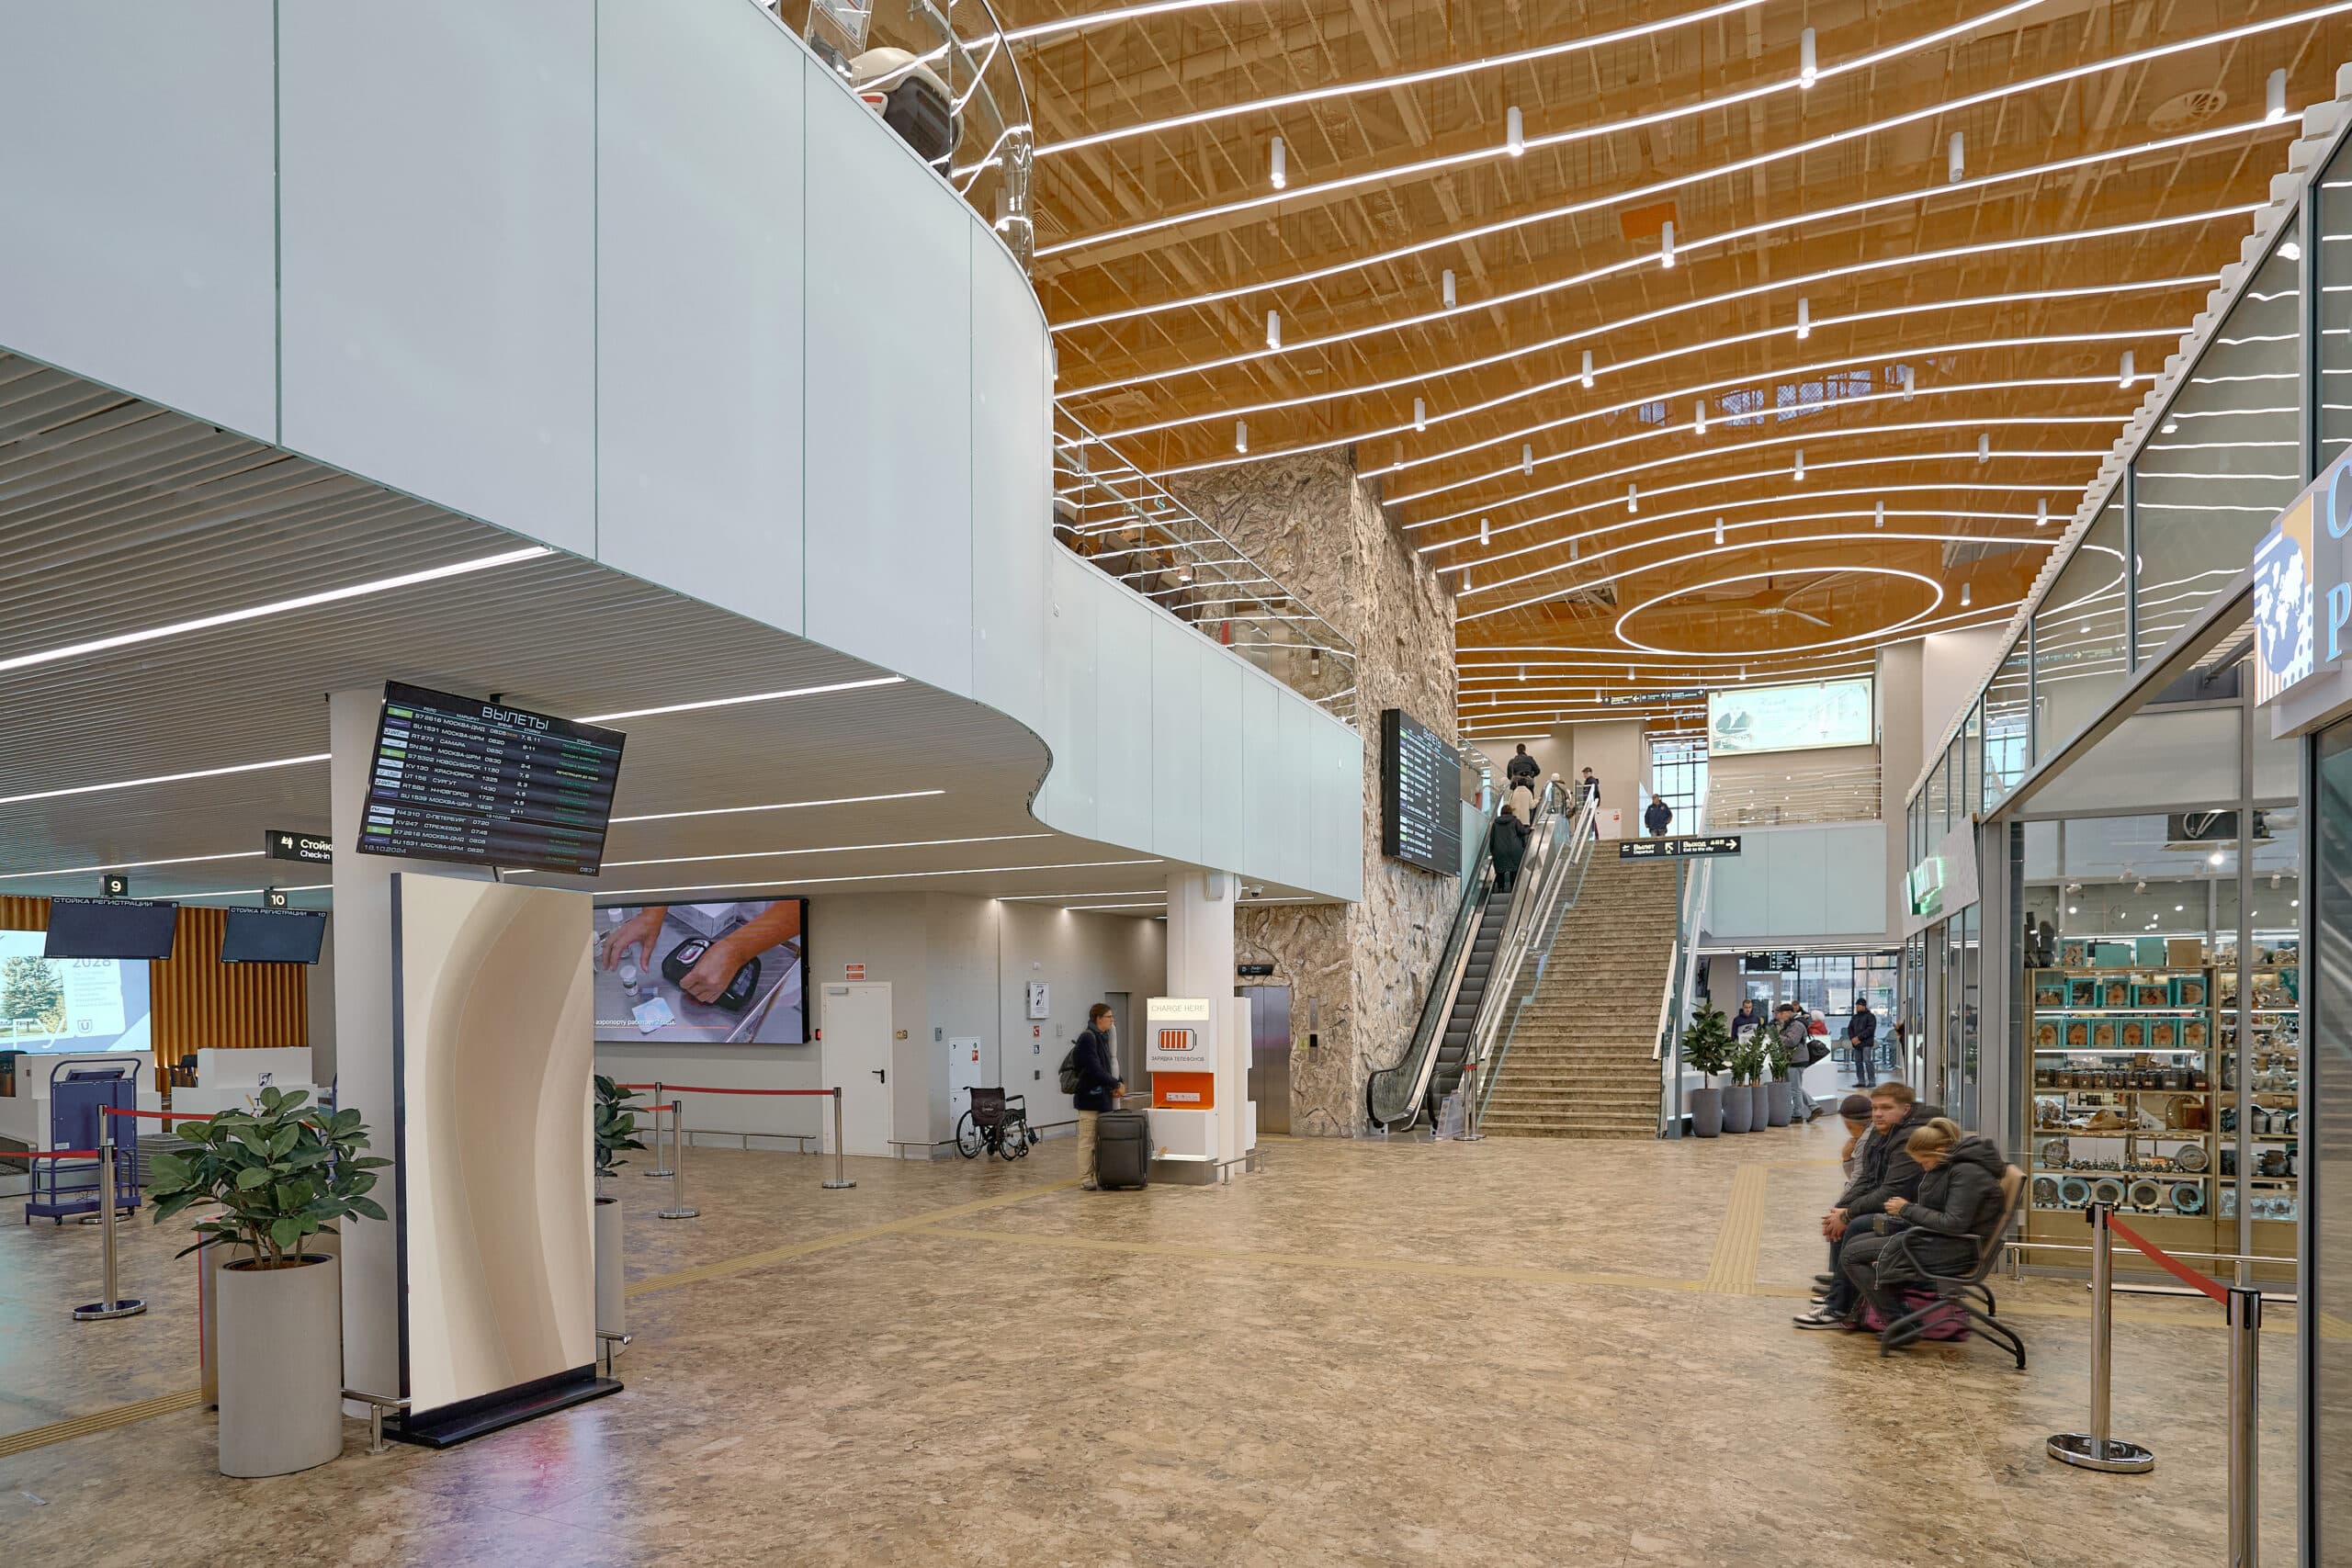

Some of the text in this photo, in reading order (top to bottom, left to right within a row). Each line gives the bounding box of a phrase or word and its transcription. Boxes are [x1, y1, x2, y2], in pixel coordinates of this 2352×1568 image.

[482, 706, 549, 730] ВЫЛЕТЫ
[442, 718, 485, 732] МОСКВА-ДМД
[423, 725, 439, 733] 1531
[441, 728, 484, 742] МОСКВА-ШРМ
[438, 738, 466, 748] САМАРА
[437, 748, 481, 761] МОСКВА-ШРМ
[435, 758, 481, 771] НОВОСИБИРСК
[433, 767, 474, 779] КРАСНОЯРСК
[432, 777, 457, 786] СУРГУТ
[429, 786, 469, 797] Н-НОВГОРОД
[427, 796, 472, 807] МОСКВА-ШРМ
[424, 813, 466, 823] С-ПЕТЕРБУРГ
[420, 841, 464, 852] МОСКВА-ШРМ
[300, 851, 331, 860] Check-in
[110, 880, 121, 893] 9
[92, 899, 153, 908] РЕГИСТРАЦИИ
[271, 895, 285, 906] 10
[260, 908, 308, 917] РЕГИСТРАЦИИ
[1151, 1004, 1205, 1012] CHARGE HERE
